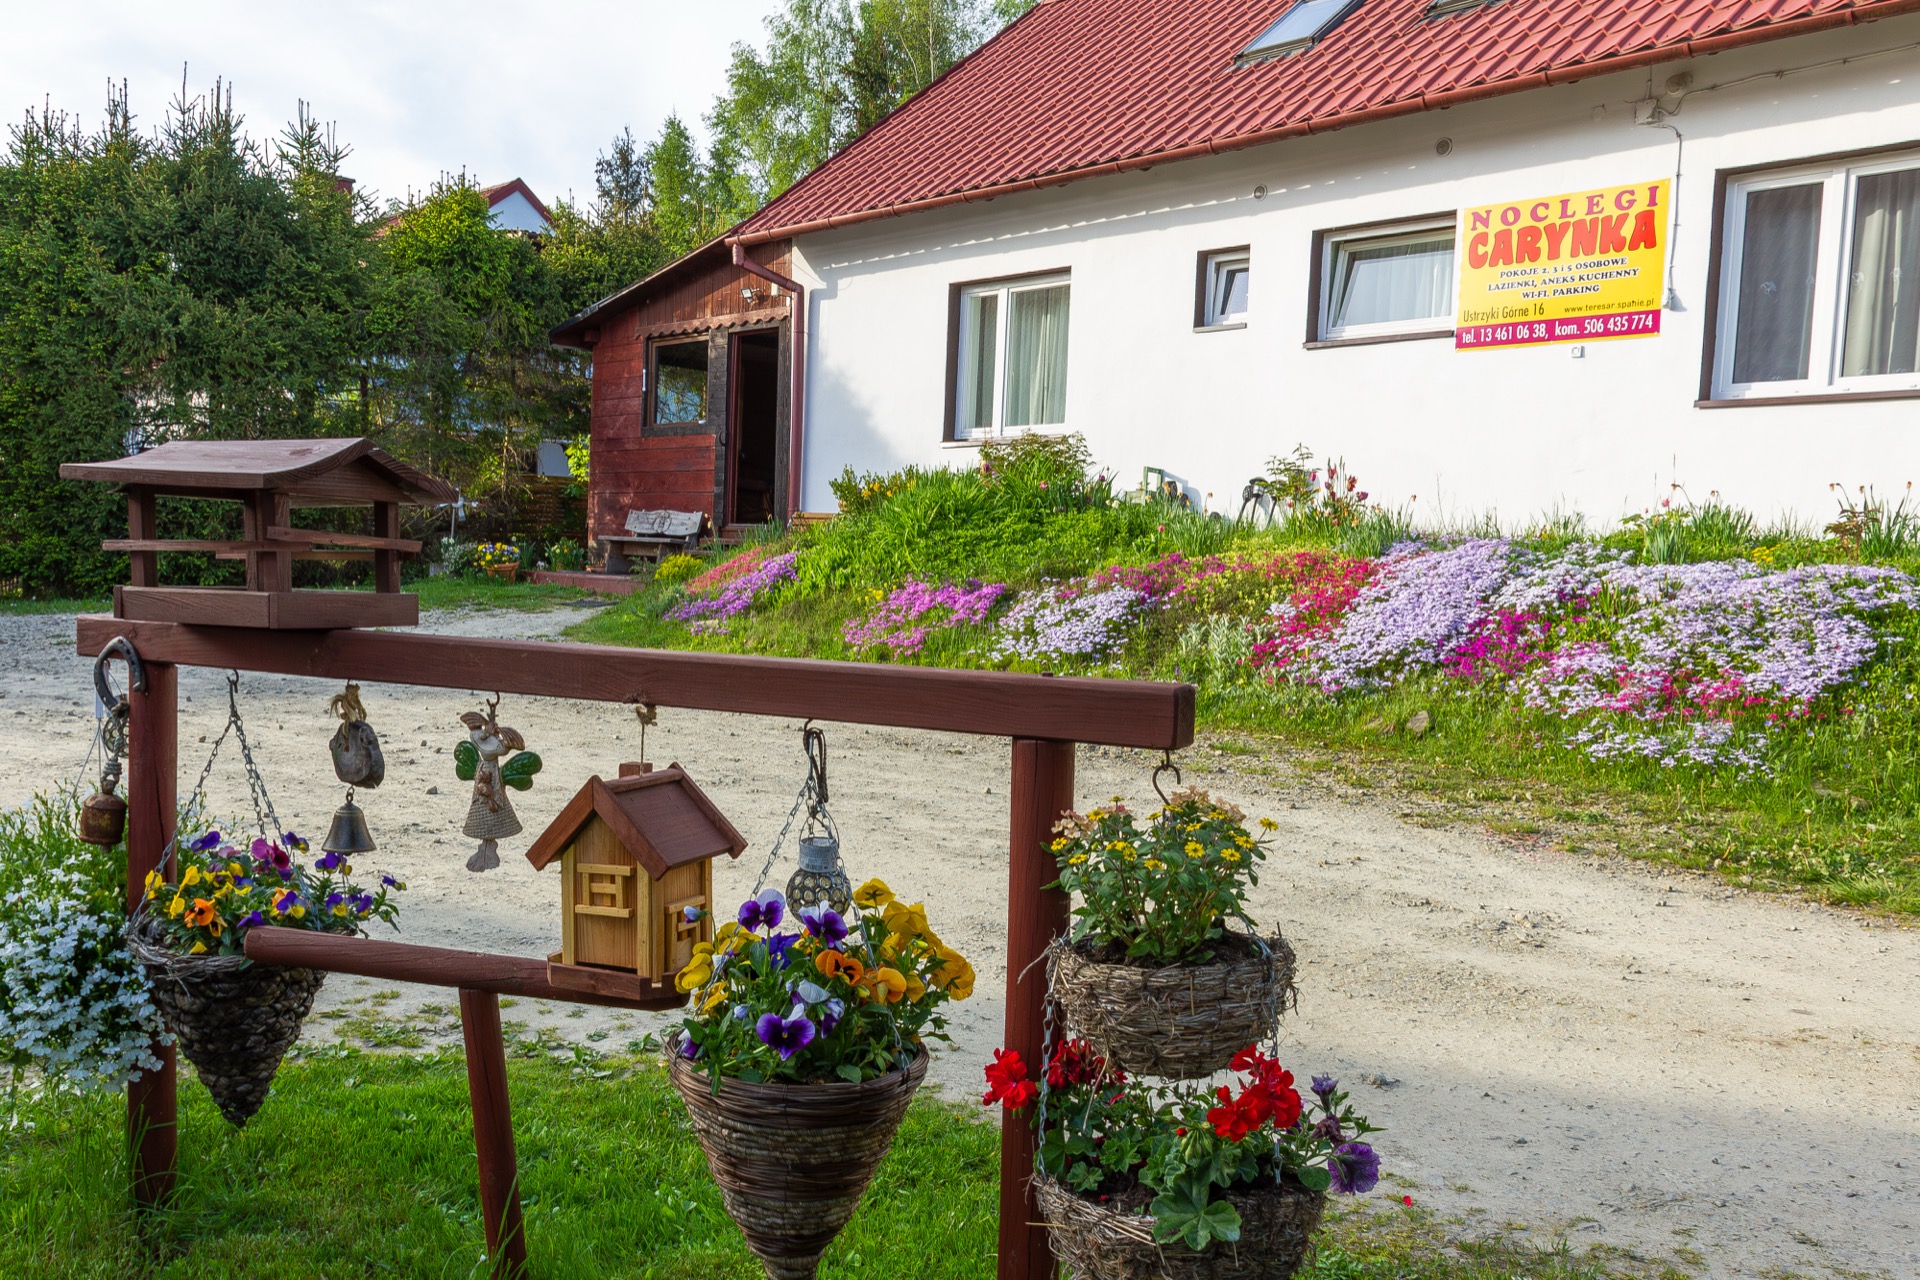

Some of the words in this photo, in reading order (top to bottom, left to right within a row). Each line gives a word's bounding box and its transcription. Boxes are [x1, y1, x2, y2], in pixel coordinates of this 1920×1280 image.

[1470, 186, 1660, 231] NOCLEGI
[1468, 209, 1657, 269] CARYNKA
[1500, 268, 1539, 278] POKOJE
[1567, 264, 1573, 272] 5
[1575, 257, 1627, 270] OSOBOWE
[1540, 275, 1575, 286] ANEKS
[1578, 268, 1639, 282] KUCHENNY
[1552, 284, 1600, 296] PARKING
[1463, 306, 1499, 323] Ustrzyki
[1502, 305, 1529, 319] Górne
[1533, 302, 1545, 316] 16
[1462, 328, 1477, 344] tel.
[1480, 328, 1492, 342] 13
[1495, 326, 1512, 341] 461
[1516, 324, 1529, 339] 06
[1532, 323, 1549, 340] 38,
[1554, 320, 1580, 336] kom.
[1583, 318, 1604, 334] 506
[1607, 315, 1629, 332] 435
[1631, 313, 1653, 330] 774
